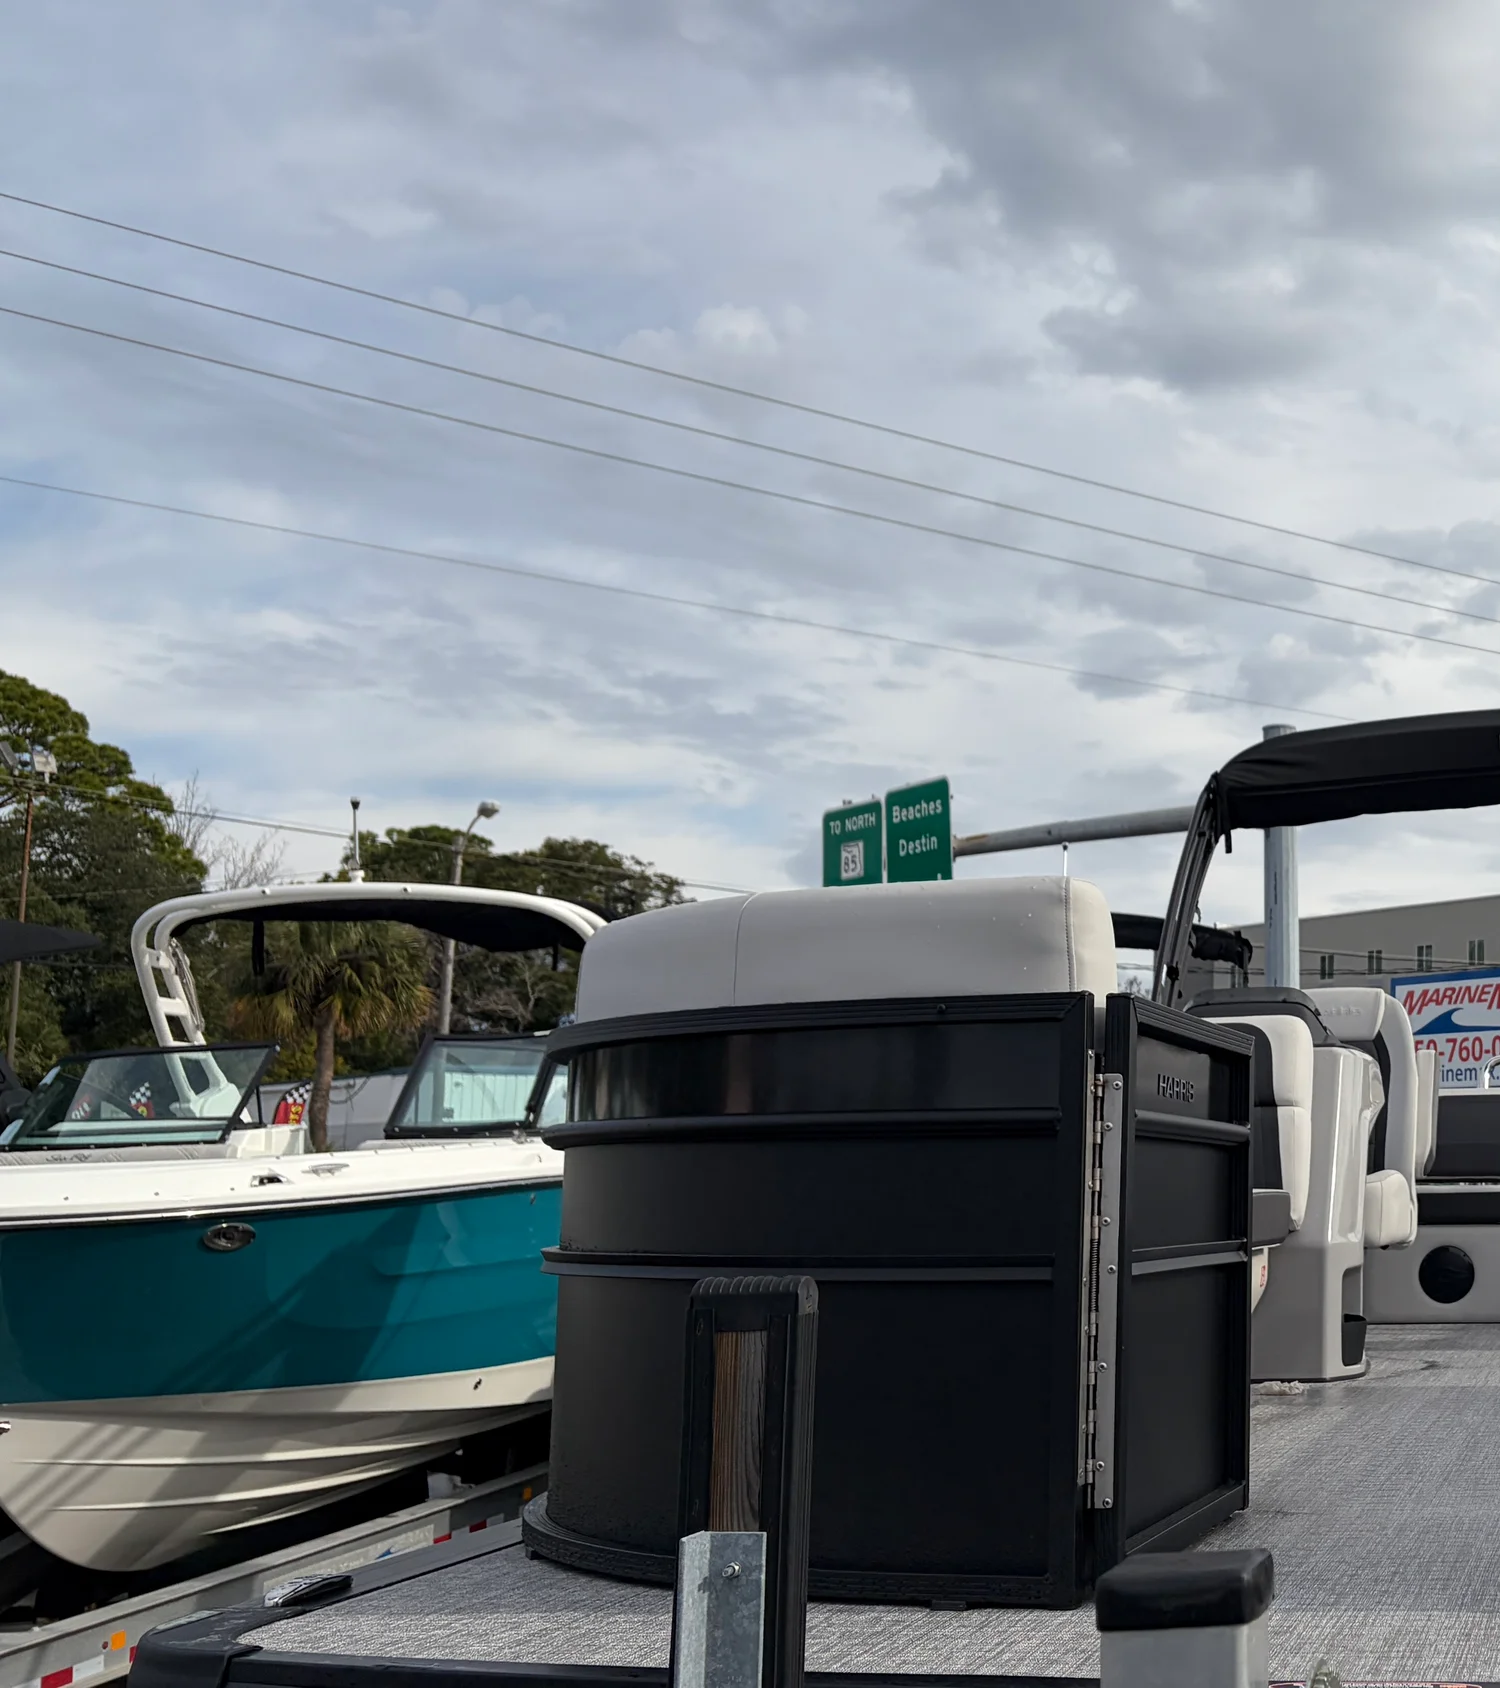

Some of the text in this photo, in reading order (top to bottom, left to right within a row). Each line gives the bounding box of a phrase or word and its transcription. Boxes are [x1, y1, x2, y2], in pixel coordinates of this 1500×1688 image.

[892, 799, 943, 824] Beaches
[829, 812, 876, 836] TO NORTH
[899, 833, 938, 857] Destin
[843, 854, 858, 874] 85
[1157, 1073, 1195, 1104] HARRIS
